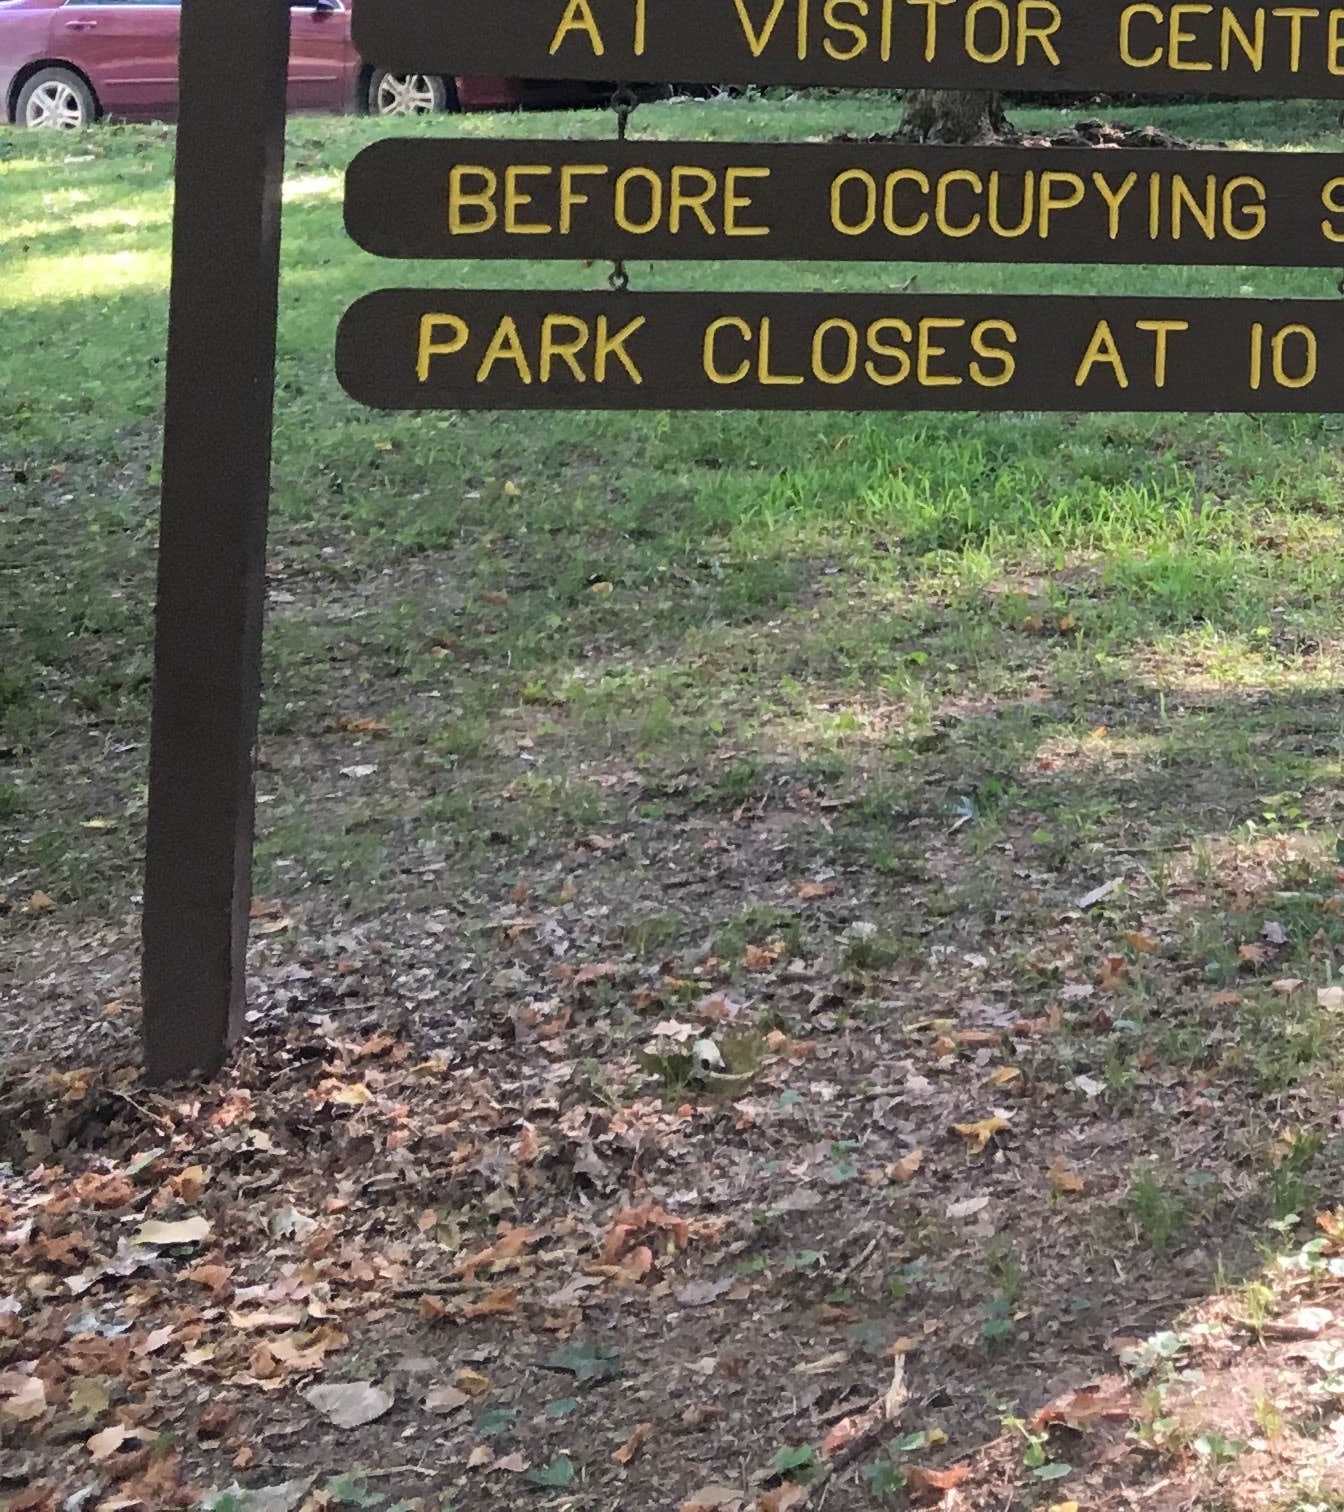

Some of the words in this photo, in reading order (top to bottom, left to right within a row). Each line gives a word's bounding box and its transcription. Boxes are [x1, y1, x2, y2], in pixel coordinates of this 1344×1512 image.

[447, 163, 771, 237] BEFORE
[829, 167, 1267, 241] OCCUPYING
[415, 312, 645, 385] PARK
[702, 316, 1018, 388] CLOSES
[1074, 319, 1189, 389] AT
[1249, 322, 1318, 390] 10
